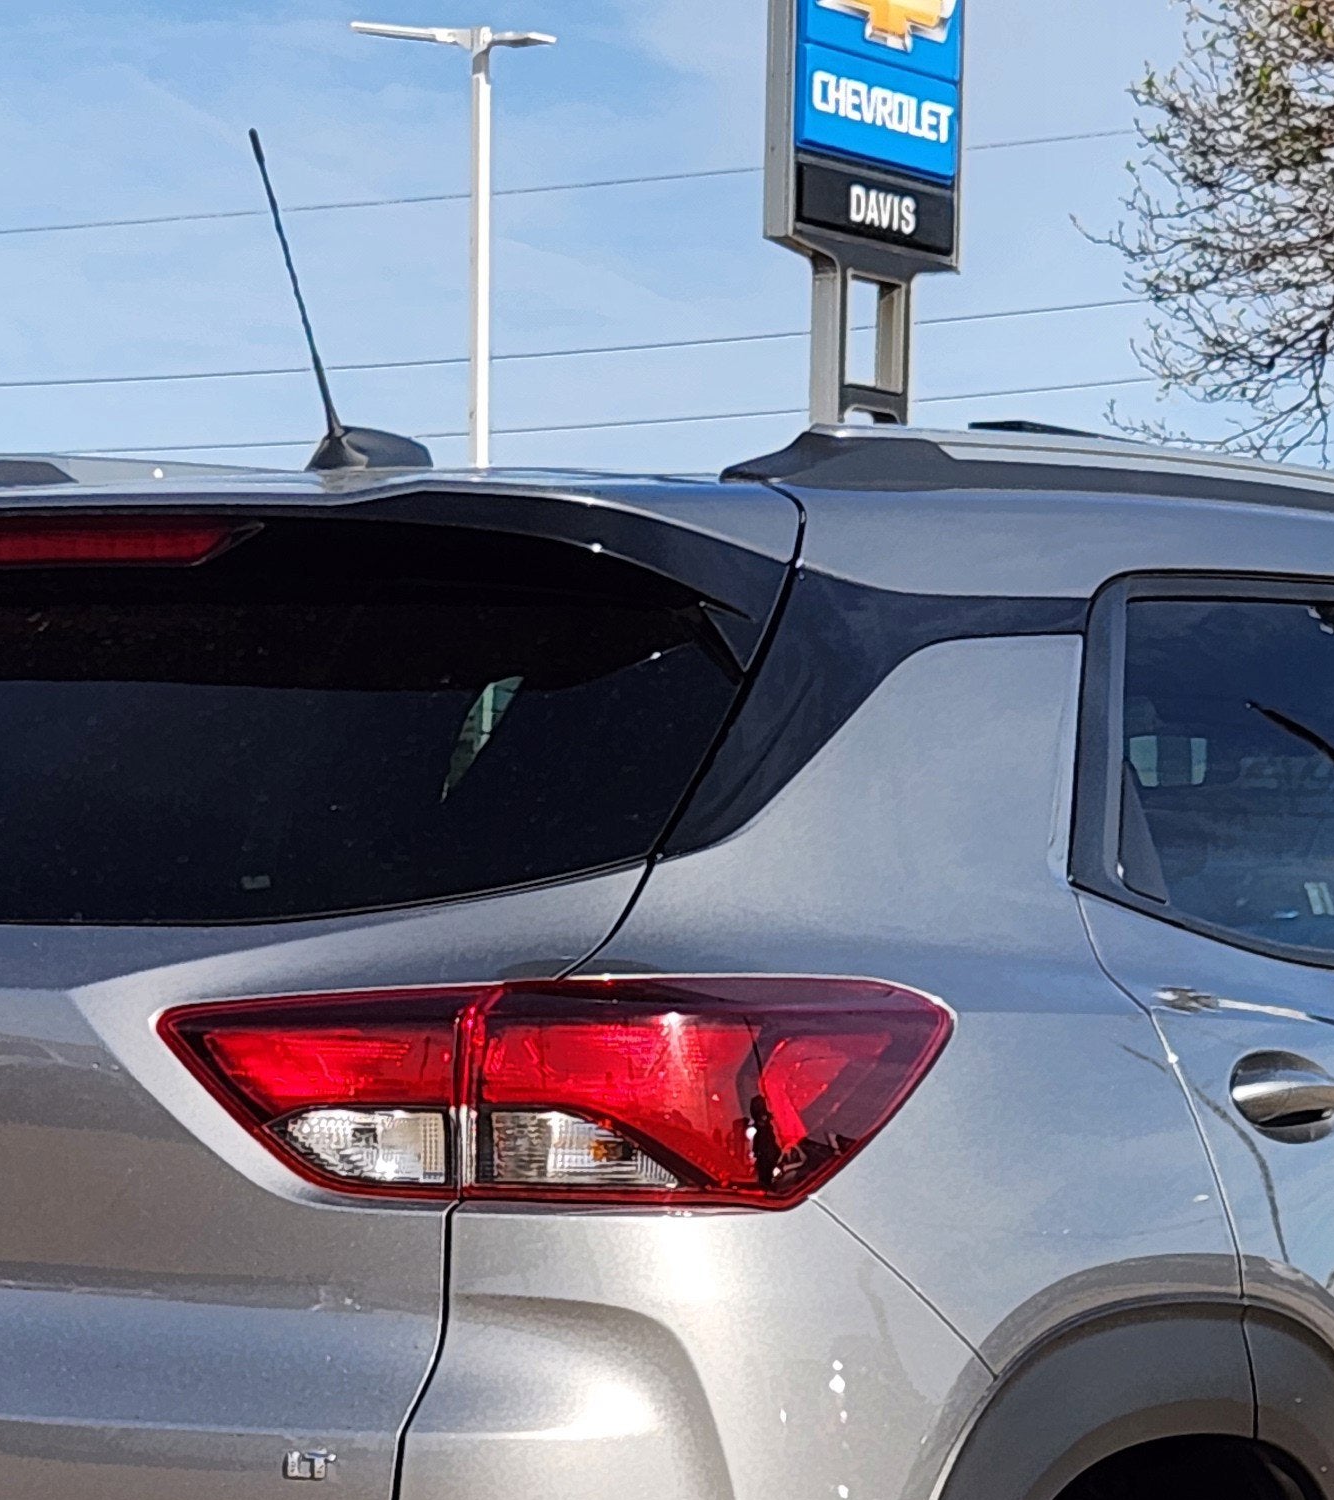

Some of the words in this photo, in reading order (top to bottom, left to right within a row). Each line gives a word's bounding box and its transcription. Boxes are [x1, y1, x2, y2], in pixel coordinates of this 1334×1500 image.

[812, 70, 955, 143] CHEVROLET
[849, 184, 917, 234] DAVIS
[285, 1448, 337, 1479] LT
